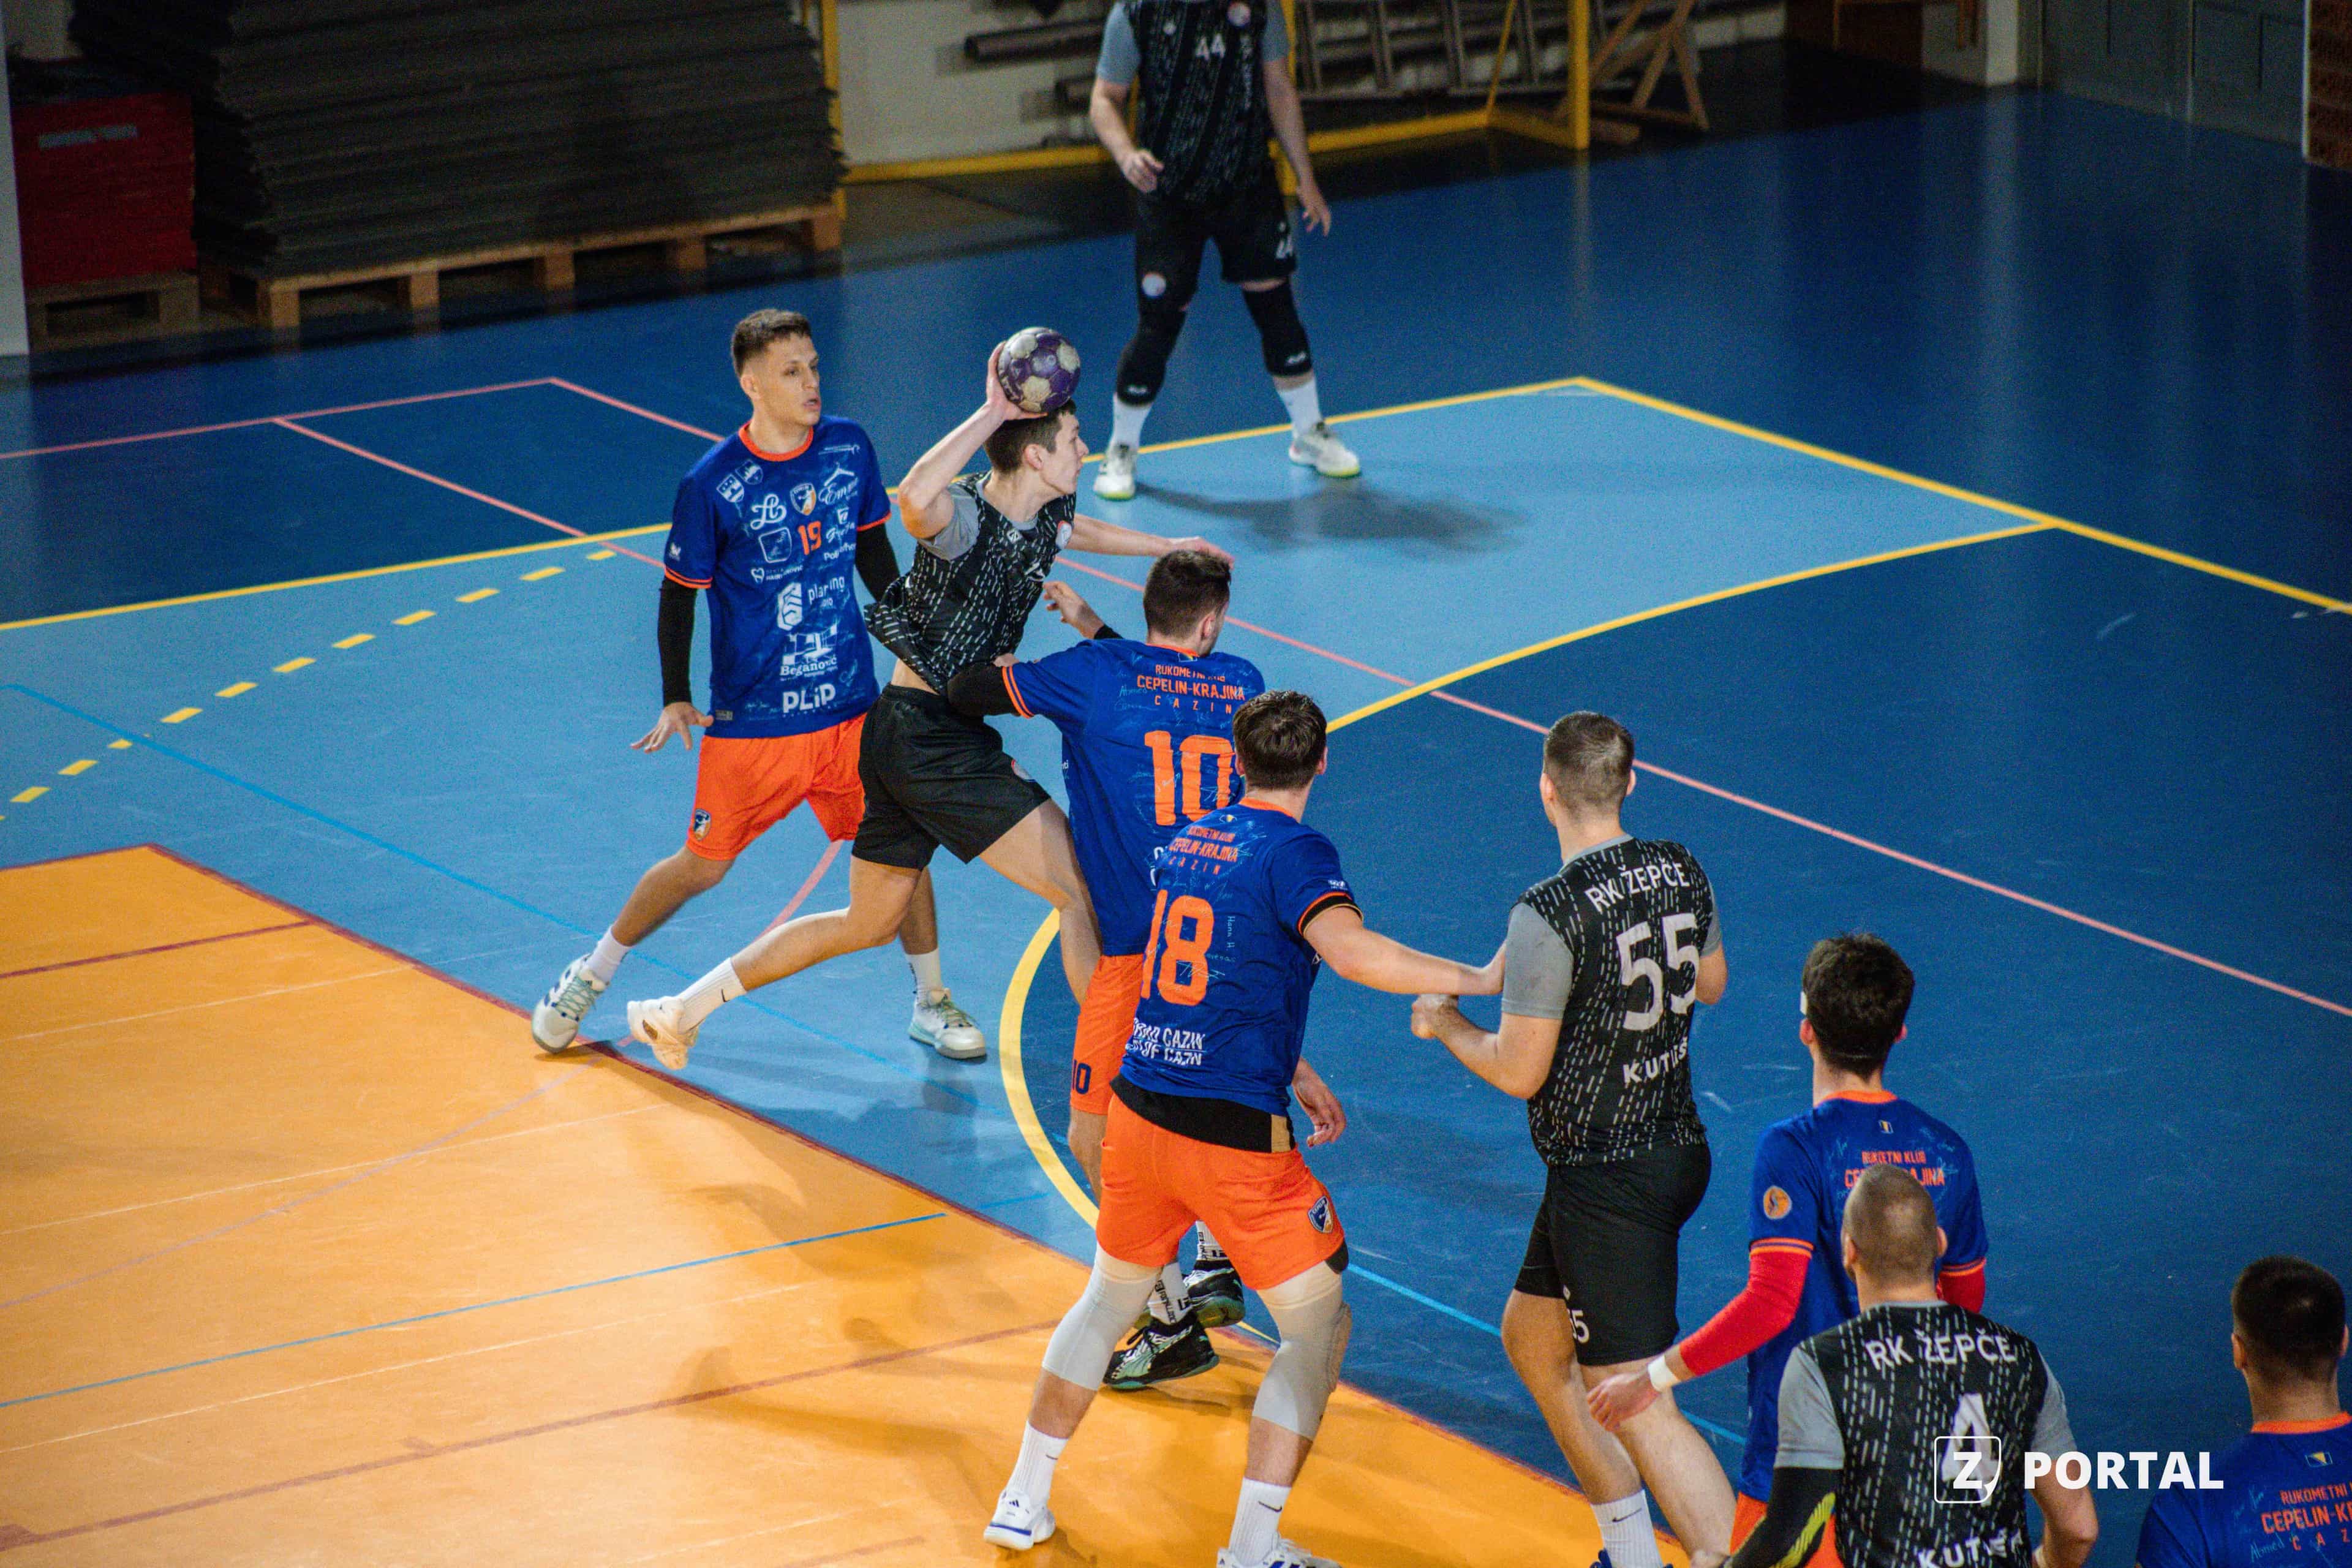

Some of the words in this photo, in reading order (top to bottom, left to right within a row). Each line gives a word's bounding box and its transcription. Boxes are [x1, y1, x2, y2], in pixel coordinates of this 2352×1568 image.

[798, 520, 822, 556] 19
[1137, 674, 1245, 701] CEPELIN-KRAJINA
[1155, 695, 1232, 714] CAZIN
[1144, 730, 1235, 826] 10
[1585, 878, 1624, 915] RK
[1618, 858, 1690, 894] ŽEPČE
[1140, 889, 1215, 1006] 18
[1616, 913, 1700, 1031] 55
[1163, 1027, 1205, 1050] CAZIN
[1072, 1059, 1091, 1095] 10
[1866, 1335, 1915, 1370] RK
[1914, 1327, 2018, 1365] ŽEPČE
[2279, 1483, 2348, 1505] RUKOMETNI
